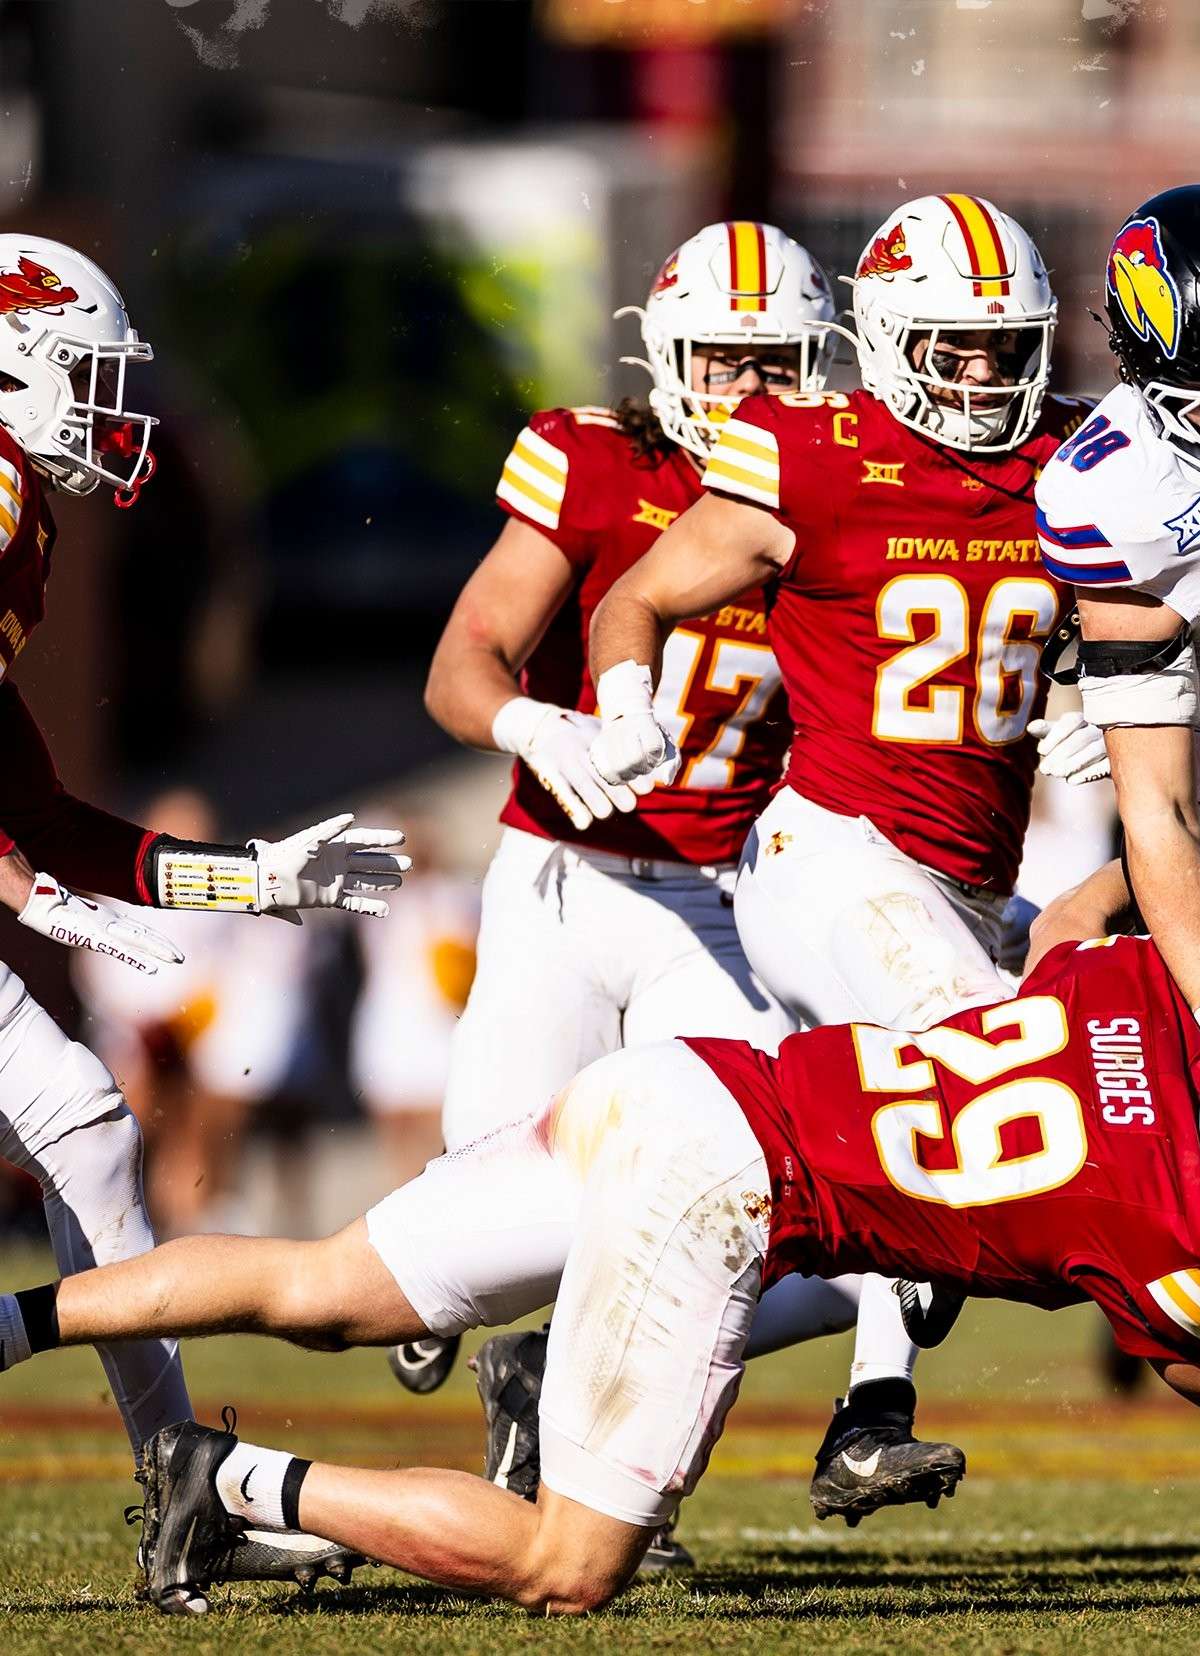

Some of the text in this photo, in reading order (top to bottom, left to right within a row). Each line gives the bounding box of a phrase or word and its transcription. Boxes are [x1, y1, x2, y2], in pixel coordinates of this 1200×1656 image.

[833, 412, 859, 448] C
[861, 460, 905, 487] XII
[886, 537, 960, 561] IOWA
[715, 605, 769, 635] STA
[872, 573, 1060, 747] 26
[50, 925, 94, 951] IOWA
[1087, 1016, 1156, 1127] SURGES
[850, 994, 1089, 1210] 29
